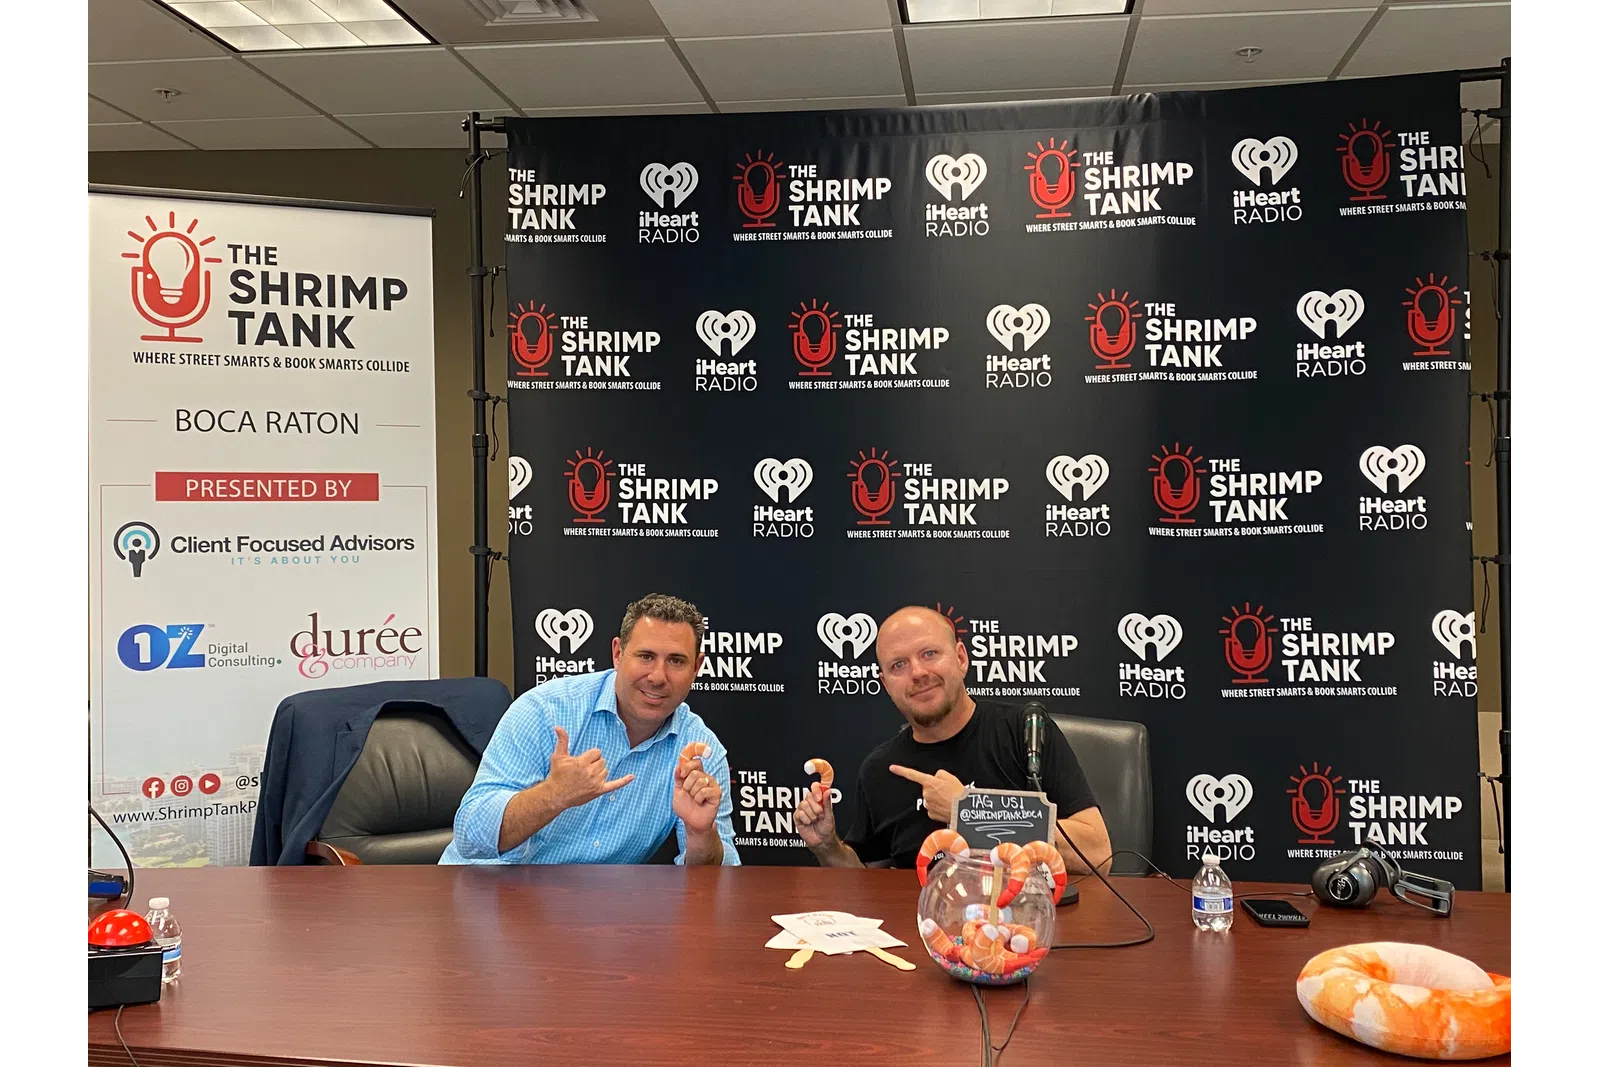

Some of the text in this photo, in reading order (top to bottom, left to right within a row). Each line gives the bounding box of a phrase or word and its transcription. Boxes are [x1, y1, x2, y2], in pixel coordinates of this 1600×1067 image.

[1398, 132, 1429, 146] THE
[1083, 151, 1113, 166] THE
[1400, 146, 1464, 171] SHRI
[509, 168, 535, 182] THE
[789, 165, 816, 178] THE
[1084, 162, 1193, 190] SHRIMP
[789, 178, 891, 202] SHRIMP
[1400, 172, 1466, 197] TAN
[509, 184, 606, 205] SHRIMP
[1084, 188, 1161, 216] TANK
[1233, 188, 1300, 207] iHeart
[508, 208, 576, 230] TANK
[640, 211, 698, 227] iHeart
[789, 204, 860, 226] TANK
[926, 203, 988, 220] iHeart
[1234, 206, 1302, 224] RADIO
[926, 220, 989, 237] RADIO
[1026, 216, 1196, 233] WHERE STREET SMARTS & BOOK SMARTS COLLIDE
[639, 228, 699, 243] RADIO
[733, 233, 757, 241] WHERE
[758, 233, 782, 241] STREET
[783, 232, 809, 240] SMARTS
[811, 232, 816, 240] &
[837, 231, 864, 239] SMARTS
[865, 230, 892, 238] COLLIDE
[227, 244, 278, 266] THE
[229, 269, 408, 311] SHRIMP
[1145, 303, 1175, 316] THE
[561, 317, 588, 328] THE
[844, 314, 873, 327] THE
[228, 310, 356, 350] TANK
[1146, 318, 1256, 342] SHRIMP
[562, 331, 660, 352] SHRIMP
[846, 328, 949, 351] SHRIMP
[1145, 344, 1222, 367] TANK
[1297, 342, 1364, 360] iHeart
[133, 351, 410, 372] WHERE STREET SMARTS & BOOK SMARTS COLLIDE
[561, 356, 630, 376] TANK
[696, 359, 756, 375] iHeart
[845, 353, 917, 375] TANK
[987, 354, 1050, 371] iHeart
[1297, 360, 1366, 378] RADIO
[696, 376, 757, 391] RADIO
[986, 372, 1052, 388] RADIO
[1085, 371, 1257, 383] WHERE STREET SMARTS & BOOK SMARTS COLLIDE
[176, 409, 359, 435] BOCA RATON
[618, 464, 645, 476] THE
[904, 464, 932, 476] THE
[1209, 459, 1240, 472] THE
[186, 479, 352, 498] PRESENTED BY
[619, 478, 718, 499] SHRIMP
[904, 478, 1009, 500] SHRIMP
[1210, 470, 1322, 497] SHRIMP
[509, 505, 533, 519] art
[618, 502, 687, 524] TANK
[754, 505, 813, 521] iHeart
[904, 504, 976, 524] TANK
[1046, 504, 1109, 520] iHeart
[1209, 498, 1288, 522] TANK
[1360, 496, 1426, 514] iHeart
[754, 523, 814, 537] RADIO
[1046, 521, 1110, 537] RADIO
[1149, 524, 1323, 537] WHERE STREET SMARTS & BOOK SMARTS COLLIDE
[1360, 514, 1427, 530] RADIO
[564, 528, 586, 536] WHERE
[588, 528, 611, 536] STREET
[665, 529, 691, 537] SMARTS
[170, 534, 415, 554] Client Focused Advisors
[231, 555, 360, 566] IT'S ABOUT YOU
[970, 620, 999, 633] THE
[1280, 618, 1312, 631] THE
[290, 612, 423, 658] durée
[700, 632, 783, 654] HRIMP
[1282, 632, 1394, 656] SHRIMP
[208, 642, 248, 657] Digital
[972, 635, 1078, 657] SHRIMP
[298, 643, 416, 679] & company
[536, 656, 595, 672] iHeart
[697, 657, 753, 678] ANK
[818, 661, 879, 678] iHeart
[1434, 661, 1477, 679] iHea
[972, 660, 1046, 682] TANK
[1120, 663, 1184, 682] iHeart
[1282, 659, 1362, 682] TANK
[819, 680, 880, 694] RADIO
[1120, 682, 1186, 699] RADIO
[1221, 687, 1397, 698] WHERE STREET SMARTS & BOOK SMARTS COLLIDE
[1434, 681, 1478, 697] RAD
[738, 771, 766, 784] THE
[1349, 780, 1380, 793] THE
[740, 786, 843, 809] SHRIP
[968, 794, 993, 810] TAG
[1350, 796, 1462, 819] SHRIMP
[740, 811, 799, 834] TAN
[1187, 826, 1254, 843] iHeart
[1349, 822, 1428, 845] TANK
[1187, 845, 1255, 861] RADIO
[1287, 849, 1314, 858] WHERE
[1403, 850, 1432, 860] SMARTS
[1434, 851, 1463, 860] COLLIDE
